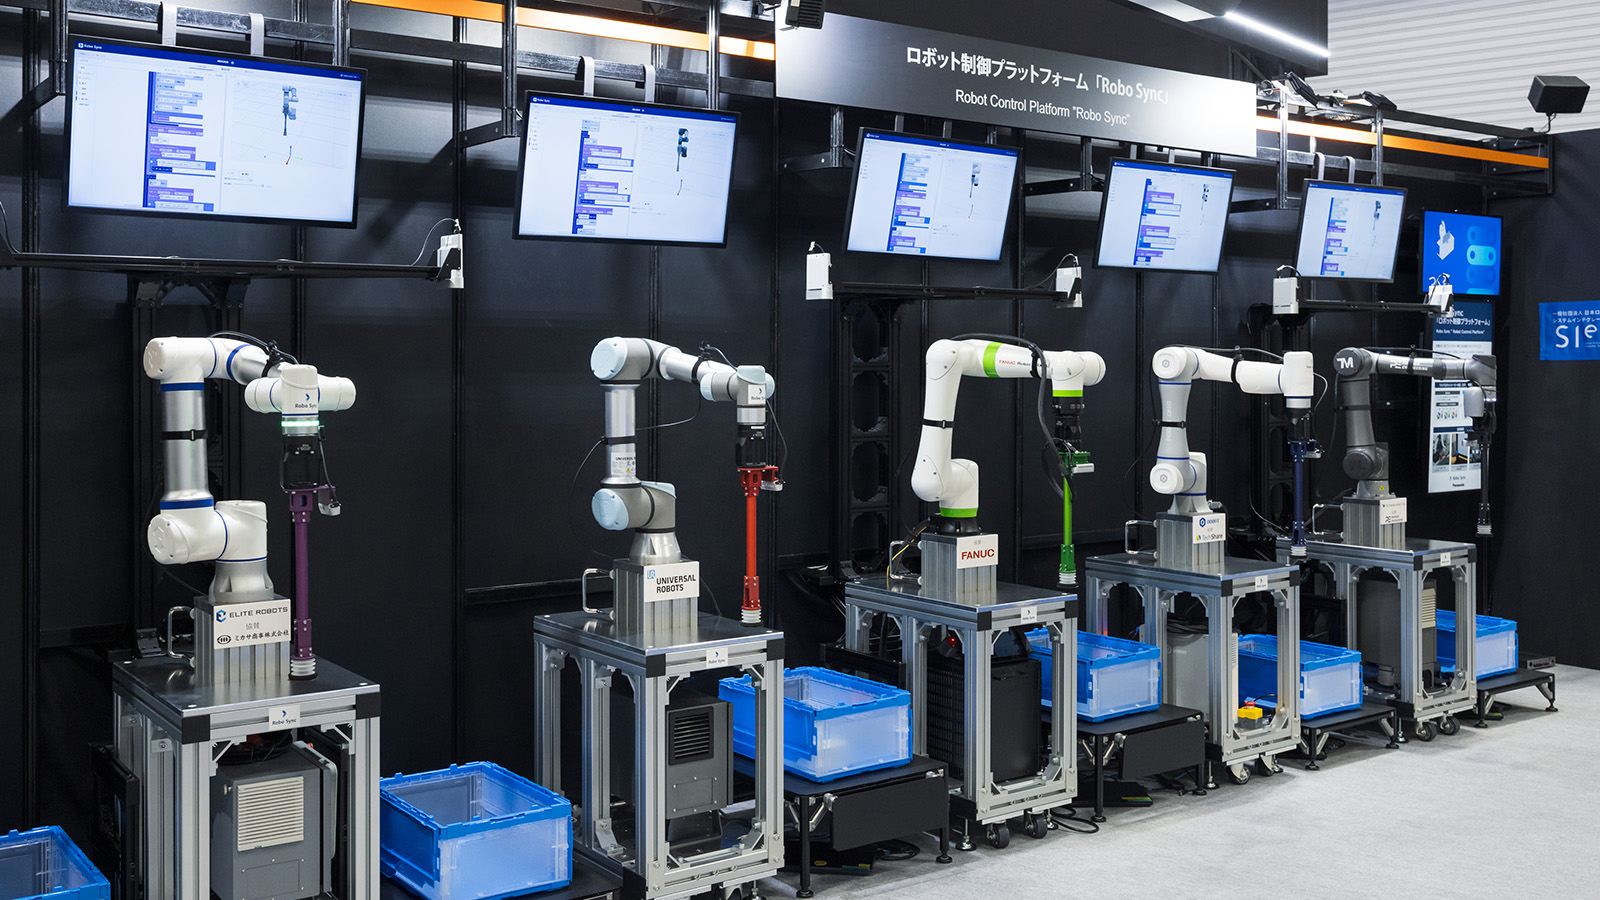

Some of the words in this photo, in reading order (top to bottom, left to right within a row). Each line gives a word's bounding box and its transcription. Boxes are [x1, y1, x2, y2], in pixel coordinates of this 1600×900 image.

[906, 46, 1089, 91] ロボット制御プラットフォーム
[955, 88, 988, 106] Robot
[989, 94, 1027, 112] Control
[1029, 99, 1070, 118] Platform
[961, 548, 995, 560] FANUC
[656, 574, 696, 585] UNIVERSAL
[656, 584, 684, 594] ROBOTS
[229, 610, 254, 618] ELITE
[255, 606, 288, 615] ROBOTS
[235, 630, 289, 641] ミカサ商事株式会社
